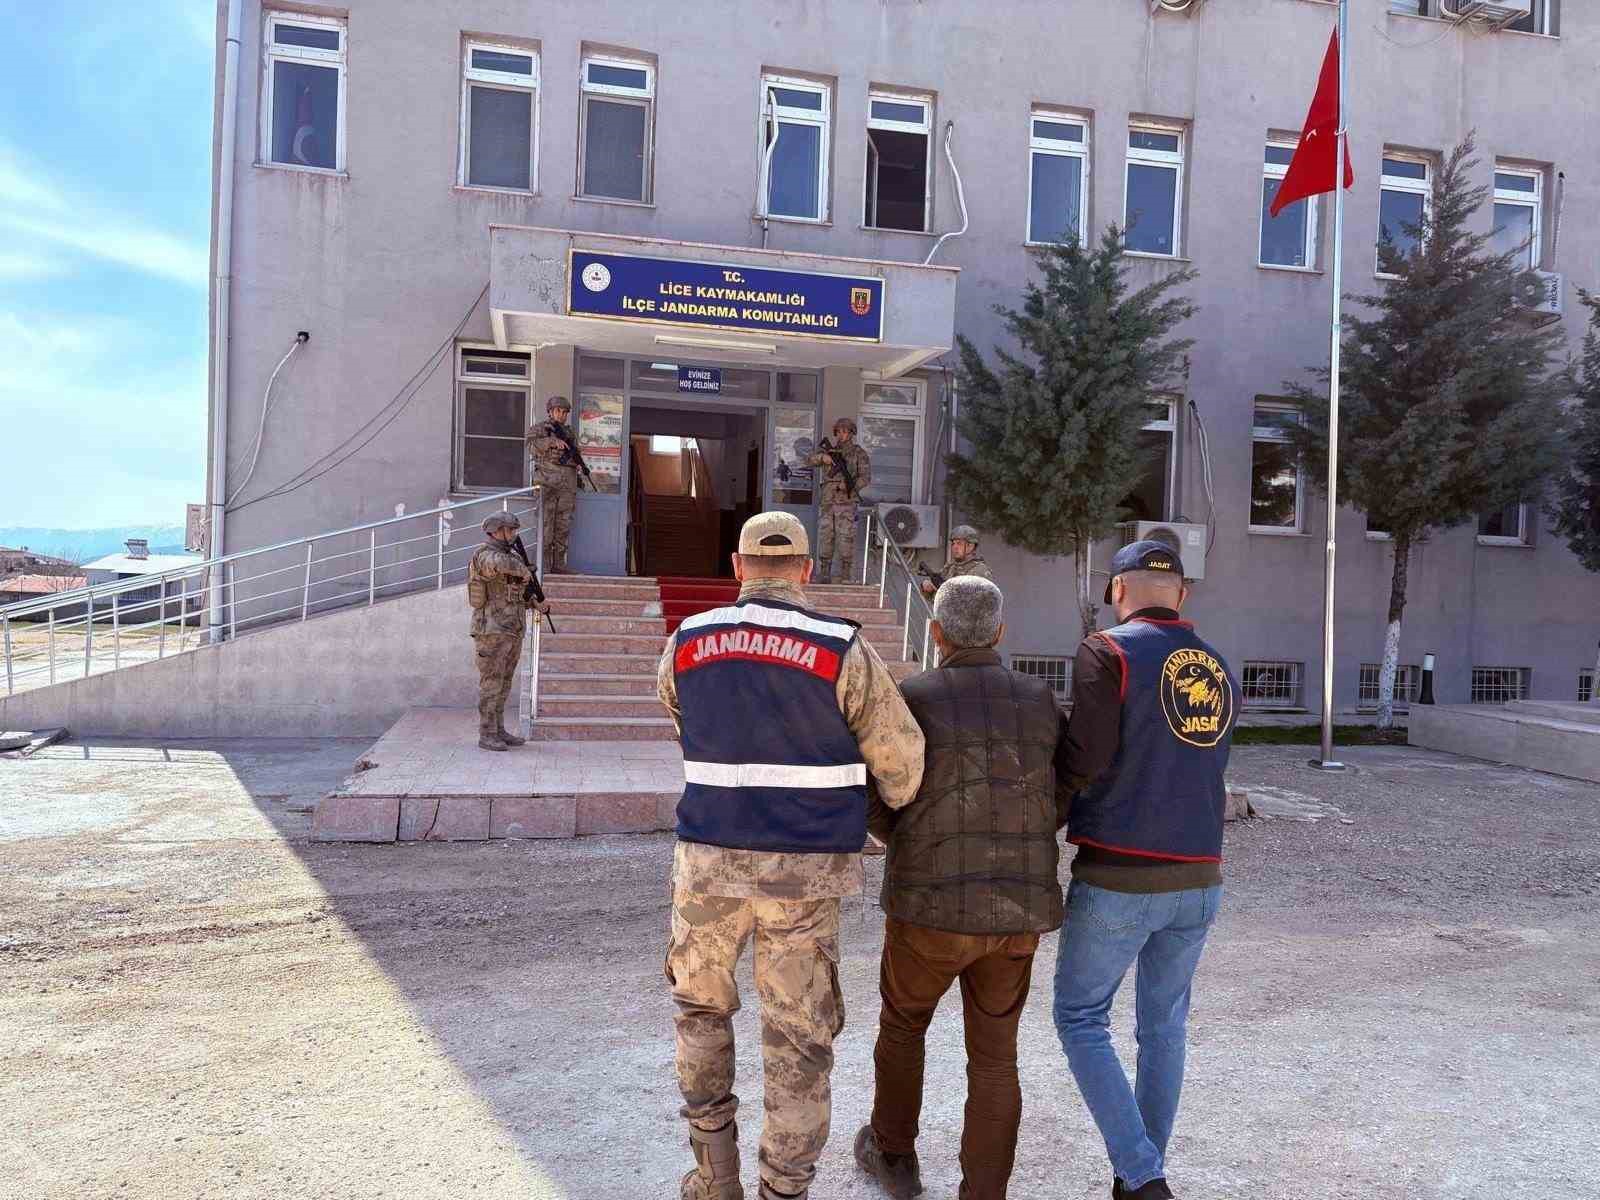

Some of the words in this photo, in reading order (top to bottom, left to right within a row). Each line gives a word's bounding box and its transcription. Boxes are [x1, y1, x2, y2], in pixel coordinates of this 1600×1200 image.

[660, 281, 693, 297] LİCE
[696, 286, 805, 307] KAYMAKAMLIĞI
[622, 295, 656, 313] İLÇE
[659, 299, 738, 318] JANDARMA
[742, 308, 838, 328] KOMUTANLIĞI
[1148, 561, 1171, 569] JASAT
[692, 630, 818, 669] JANDARMA
[1165, 651, 1225, 682] JANDARMA
[1181, 716, 1220, 733] JASAT
